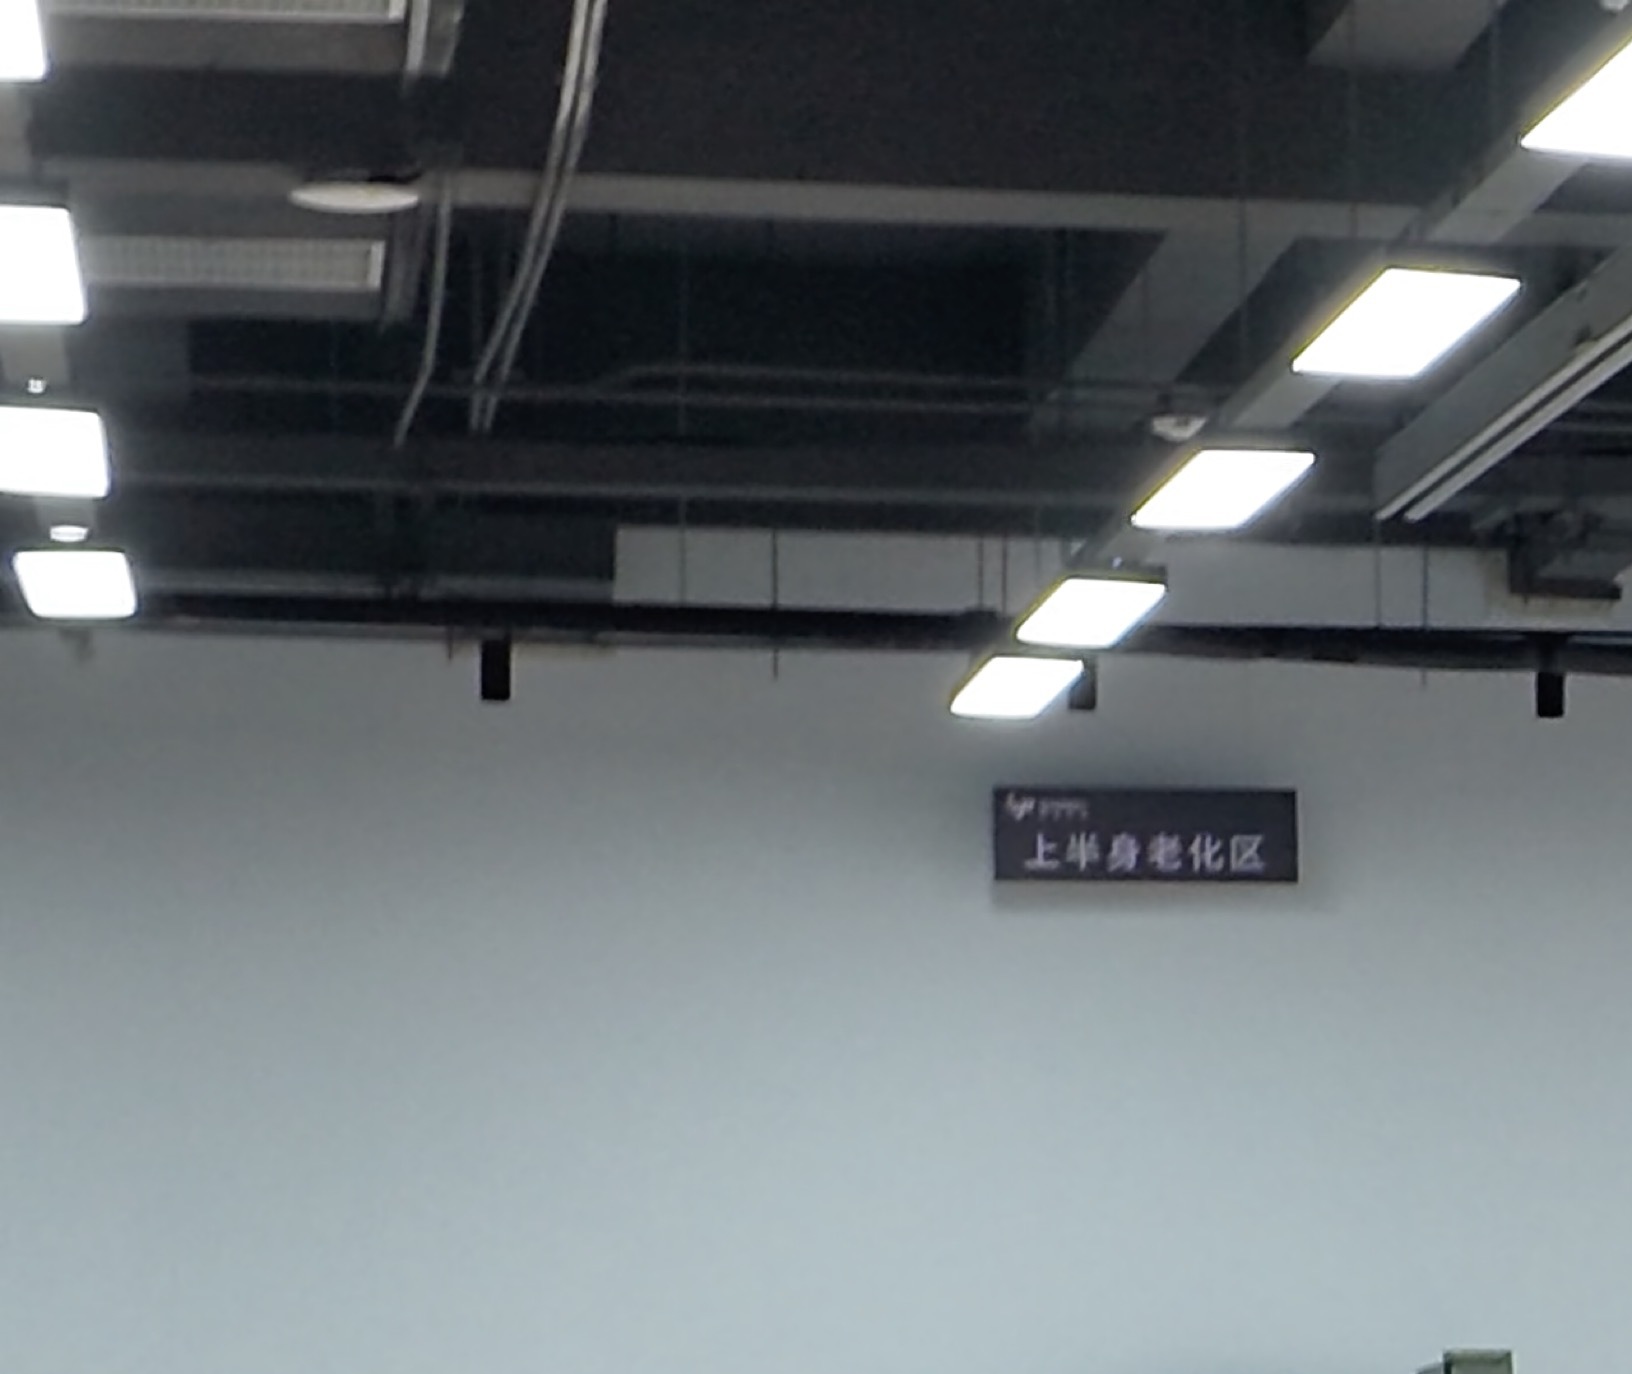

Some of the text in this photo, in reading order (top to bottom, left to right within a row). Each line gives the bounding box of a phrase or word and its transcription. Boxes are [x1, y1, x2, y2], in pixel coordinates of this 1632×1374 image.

[1025, 832, 1266, 872] 上半身老化区
